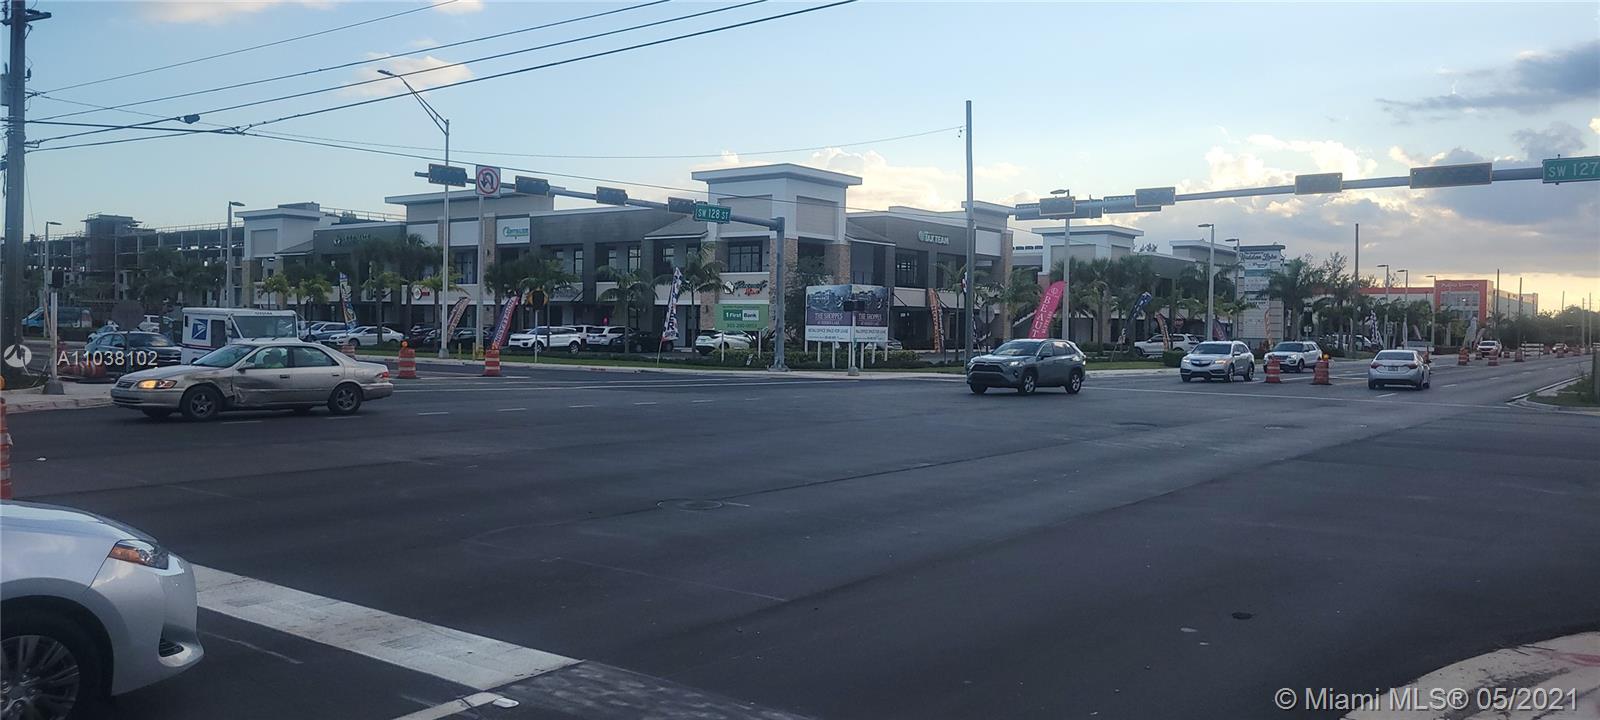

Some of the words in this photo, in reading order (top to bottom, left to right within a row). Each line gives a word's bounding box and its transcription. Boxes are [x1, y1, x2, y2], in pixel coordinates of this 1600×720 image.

[1548, 165, 1567, 178] SW
[1572, 161, 1600, 177] 127
[697, 208, 707, 217] SW
[708, 208, 720, 219] 128
[721, 211, 729, 220] ST
